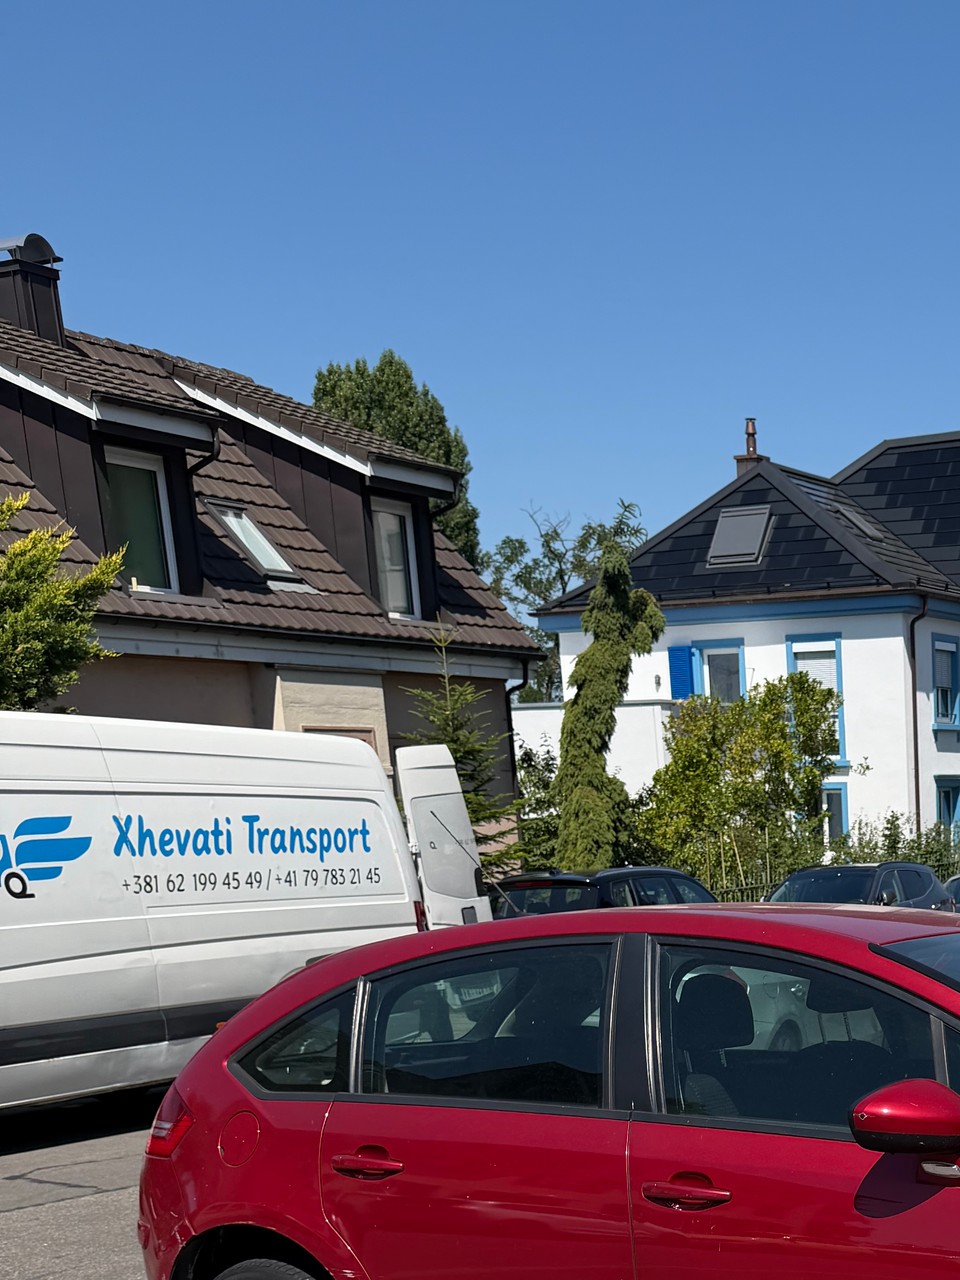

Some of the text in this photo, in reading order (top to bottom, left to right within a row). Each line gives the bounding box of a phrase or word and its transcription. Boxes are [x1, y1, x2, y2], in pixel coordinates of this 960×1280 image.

[112, 814, 371, 863] Xhevati Transport
[122, 874, 159, 894] +381
[166, 873, 185, 893] 62
[192, 872, 217, 891] 199
[222, 871, 241, 890] 45
[245, 870, 262, 889] 49
[275, 869, 298, 887] +41
[303, 869, 319, 887] 79
[323, 868, 346, 886] 783
[349, 867, 361, 885] 21
[366, 867, 381, 884] 45
